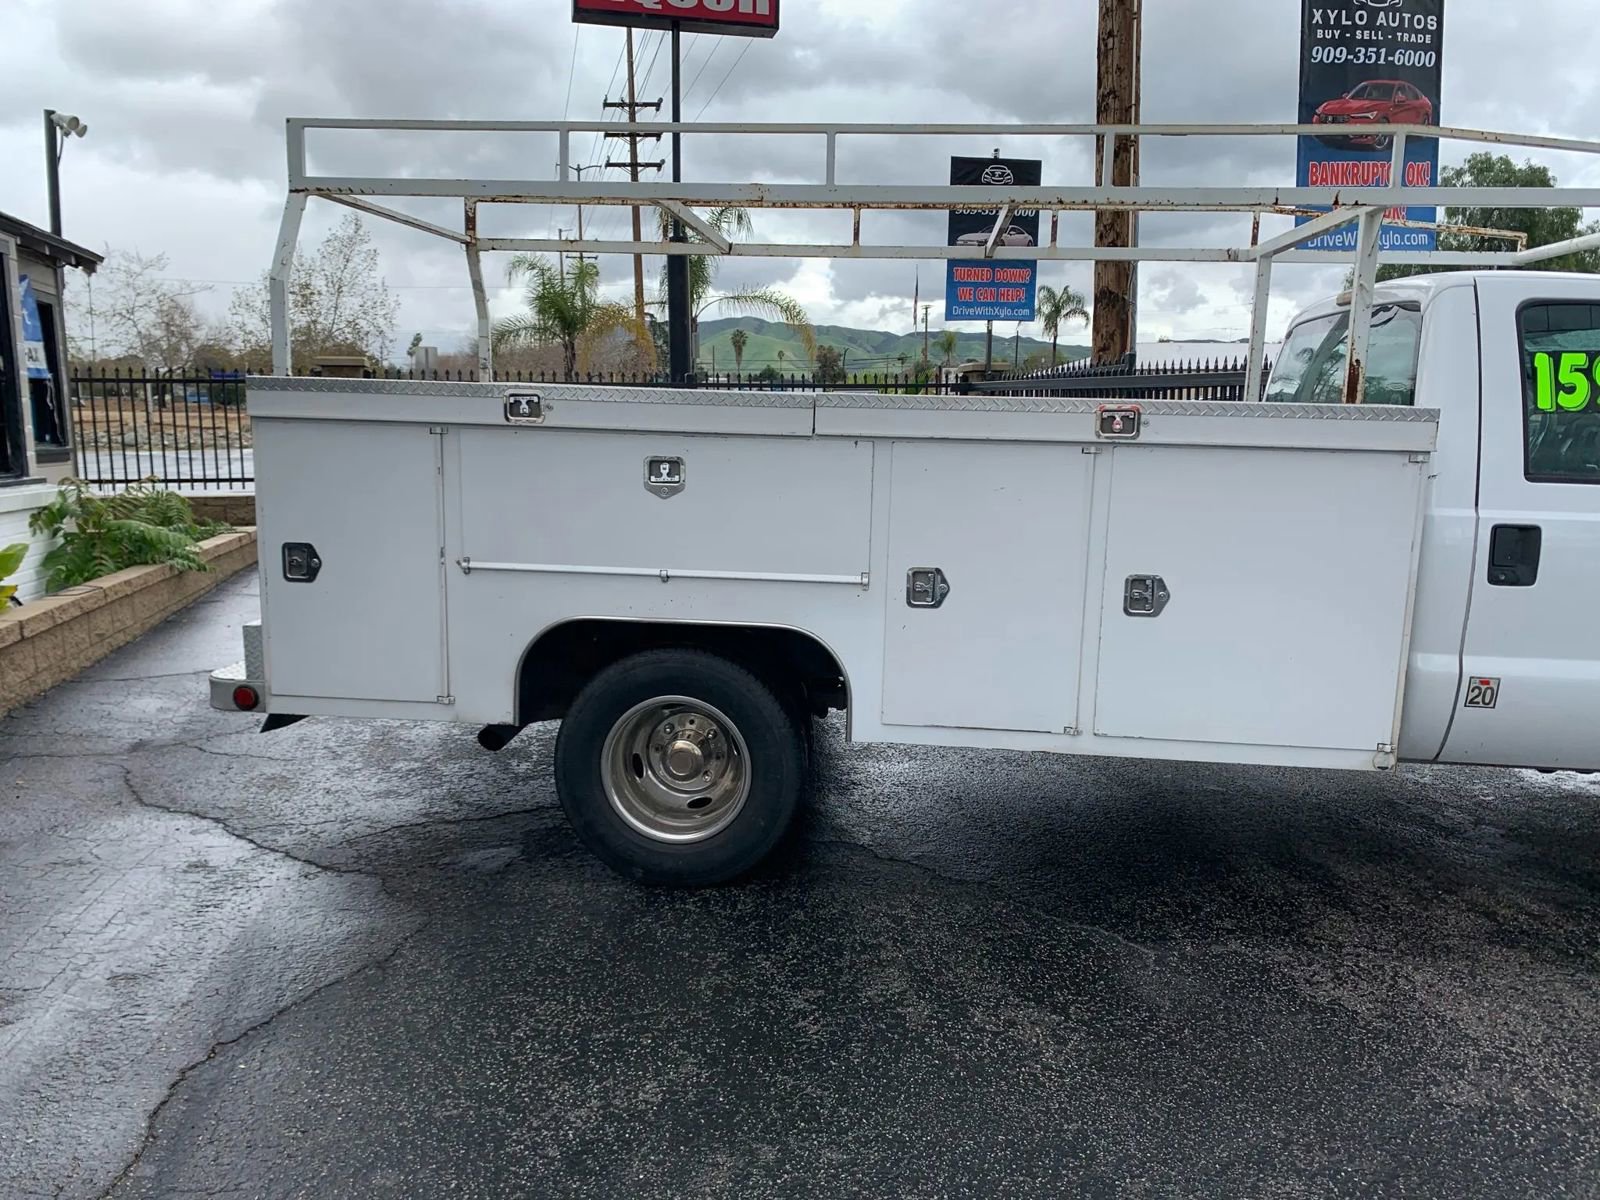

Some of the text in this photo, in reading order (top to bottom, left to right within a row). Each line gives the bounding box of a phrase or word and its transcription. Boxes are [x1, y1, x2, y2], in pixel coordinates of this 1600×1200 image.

[1312, 9, 1437, 30] XYLO AUTOS
[1316, 29, 1341, 39] BUY
[1355, 30, 1384, 40] SELL
[1397, 32, 1432, 44] TRADE
[1311, 46, 1436, 67] 909-351-6000
[1309, 161, 1431, 186] BANKRUPT OK!
[1308, 230, 1428, 249] riveWylo.com
[953, 267, 1032, 284] TURNED DOWN?
[958, 286, 1026, 303] WE CAN HELP!
[952, 305, 1030, 318] DriveWithXylo.com
[1534, 352, 1600, 412] 15
[1468, 685, 1495, 706] 20
